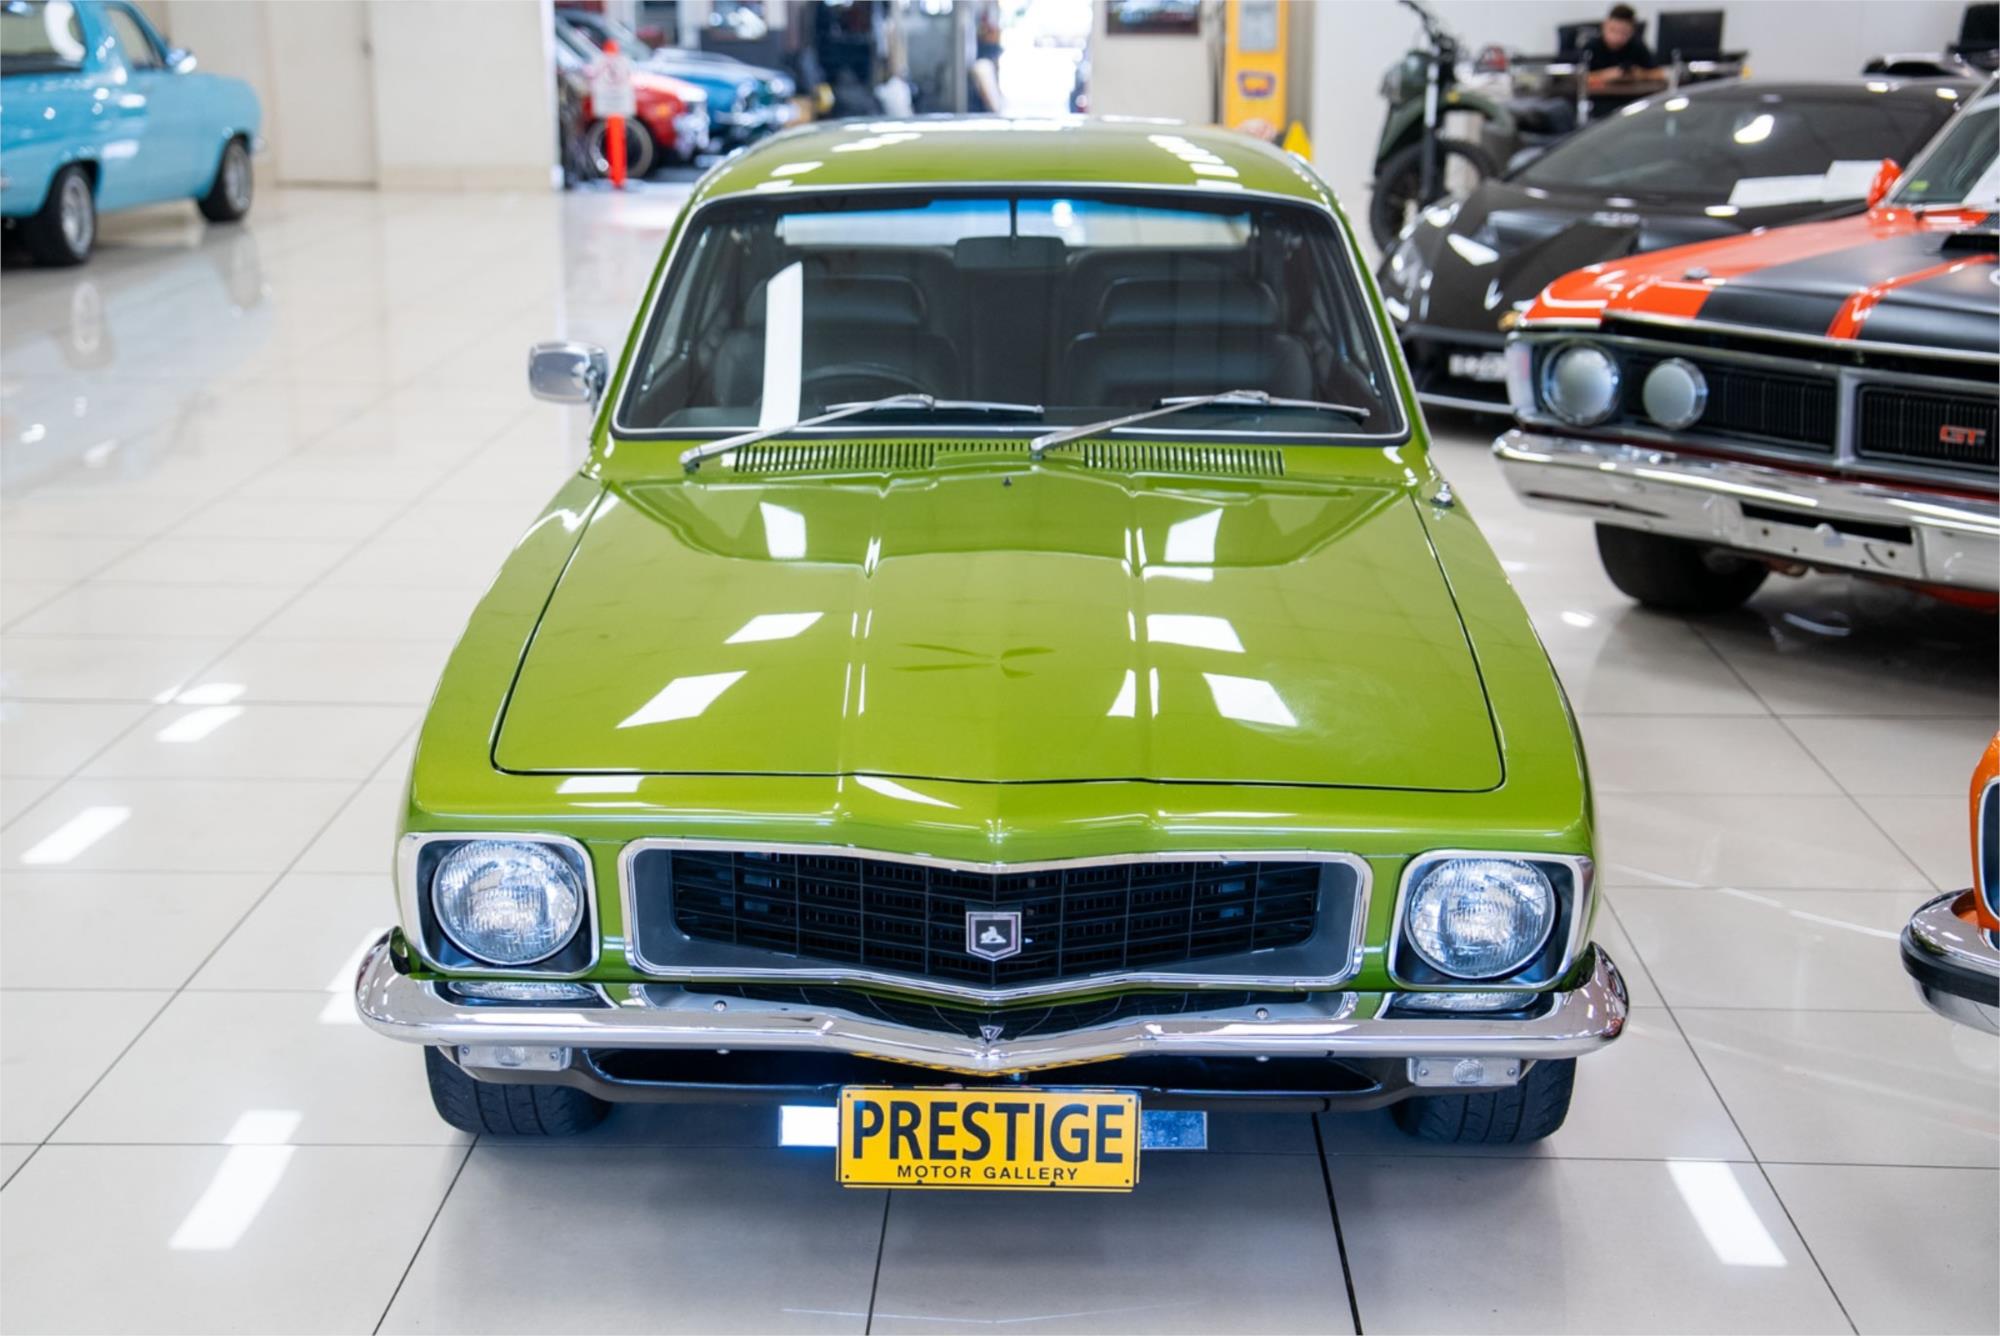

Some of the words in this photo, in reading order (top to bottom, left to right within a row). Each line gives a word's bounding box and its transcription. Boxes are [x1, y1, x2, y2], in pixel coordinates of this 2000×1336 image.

[1939, 425, 1986, 446] GT
[853, 1100, 1125, 1162] PRESTIGE
[897, 1165, 971, 1178] MOTOR
[984, 1166, 1078, 1180] GALLERY
